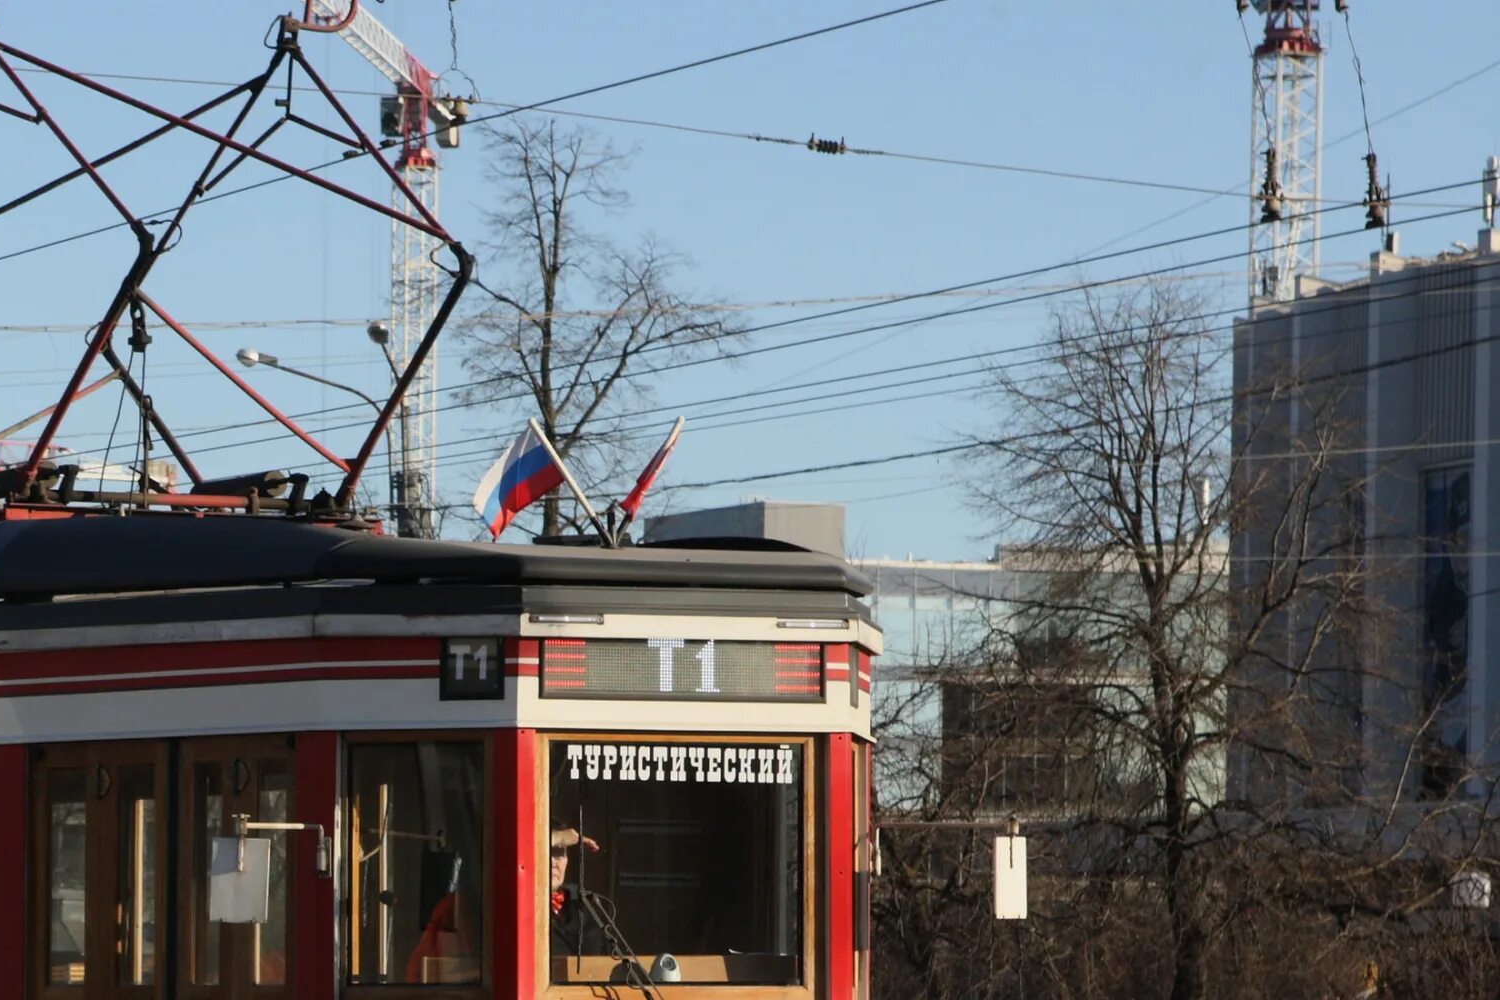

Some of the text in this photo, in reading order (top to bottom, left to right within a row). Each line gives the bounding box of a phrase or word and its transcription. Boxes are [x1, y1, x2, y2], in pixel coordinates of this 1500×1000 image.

[449, 643, 487, 681] Т1
[647, 637, 720, 693] Т1
[567, 744, 793, 784] ТУРИСТИЧЕСКИЙ
